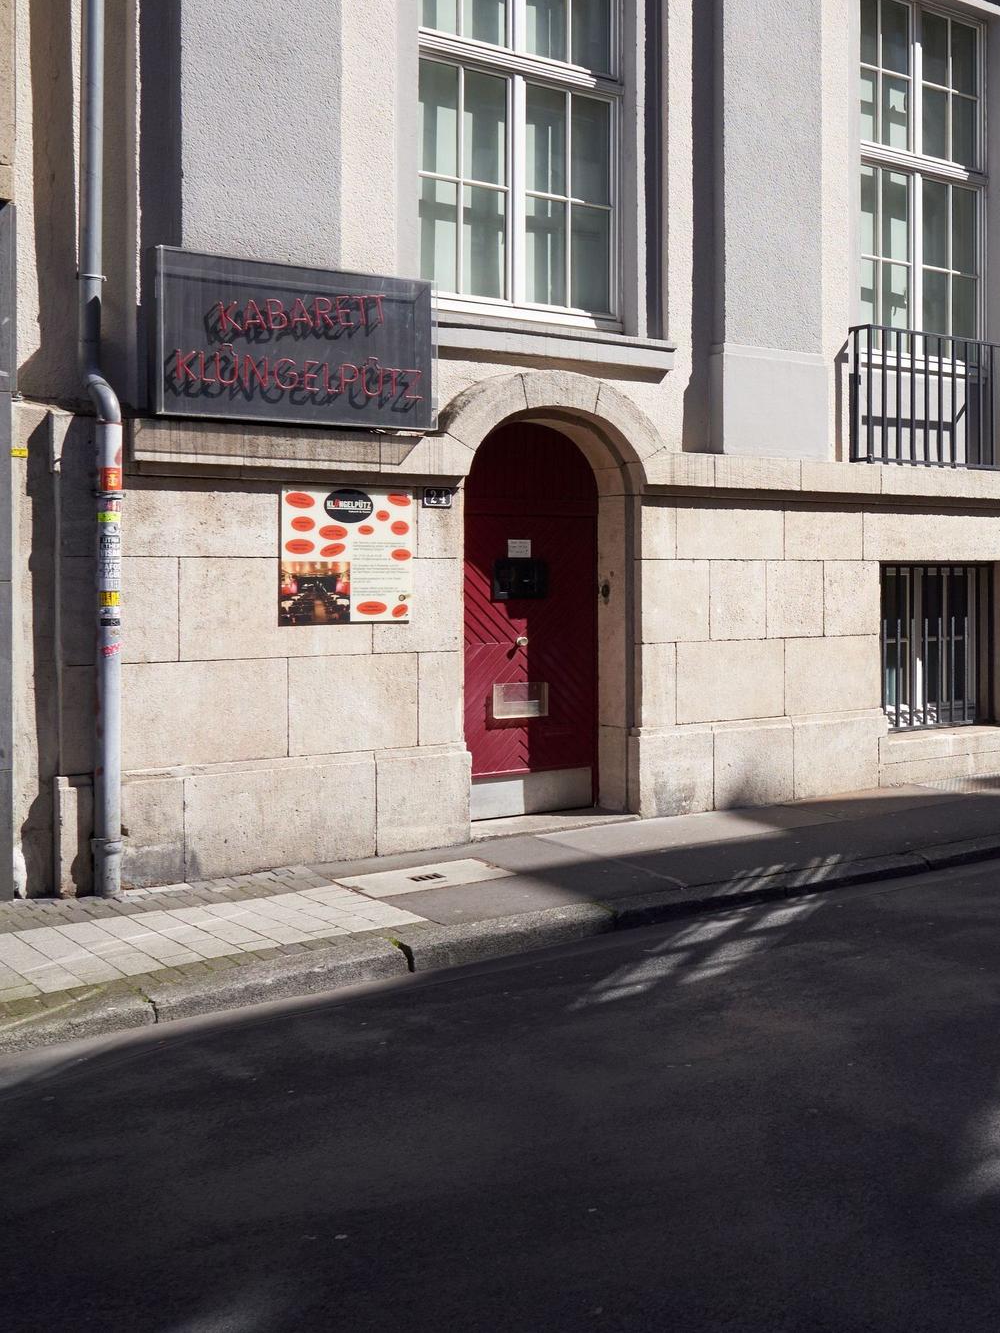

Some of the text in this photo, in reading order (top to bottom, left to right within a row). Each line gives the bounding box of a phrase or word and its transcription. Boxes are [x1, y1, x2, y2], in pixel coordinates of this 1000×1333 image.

[217, 294, 386, 332] KABARETT
[174, 342, 423, 400] KLÜNGELPÜTZ
[430, 490, 447, 504] 24
